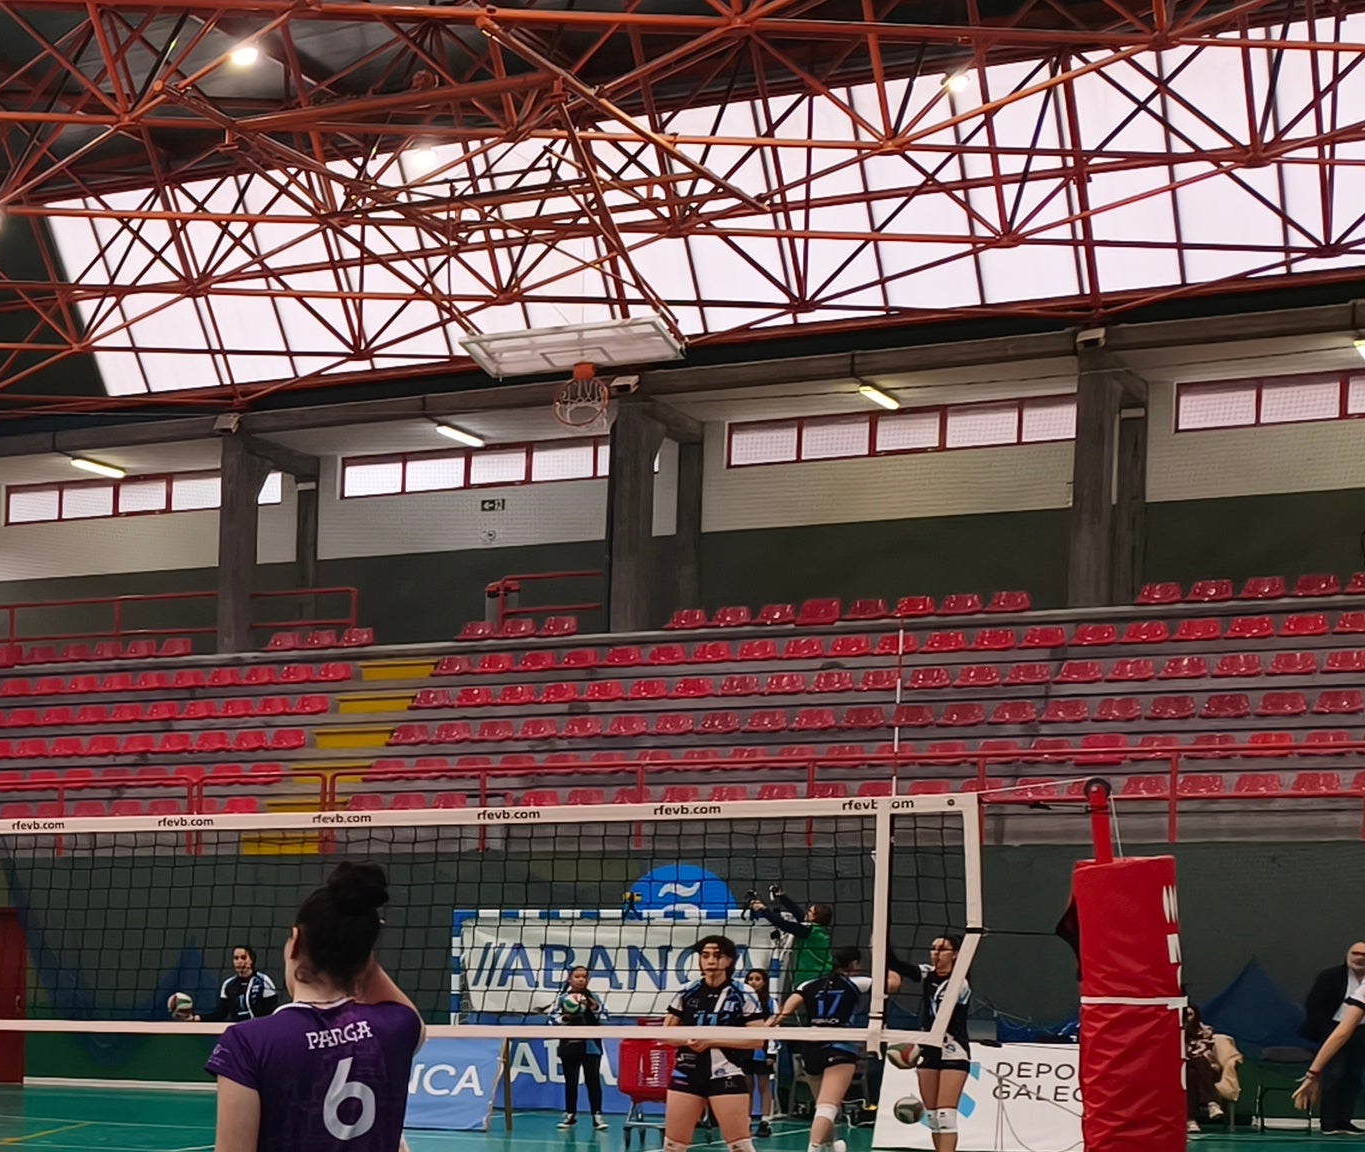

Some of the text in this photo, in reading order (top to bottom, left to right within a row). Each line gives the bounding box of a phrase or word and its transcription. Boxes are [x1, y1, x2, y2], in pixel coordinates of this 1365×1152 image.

[477, 807, 540, 820] rfevb.com
[653, 803, 721, 815] rfevb.com
[158, 816, 213, 828] rfevb.com
[312, 812, 372, 824] rfevb.com
[11, 819, 65, 831] rfevb.com
[305, 1020, 374, 1050] PARGA
[996, 1062, 1075, 1080] DEPO
[323, 1057, 376, 1141] 6
[993, 1084, 1083, 1102] GALE
